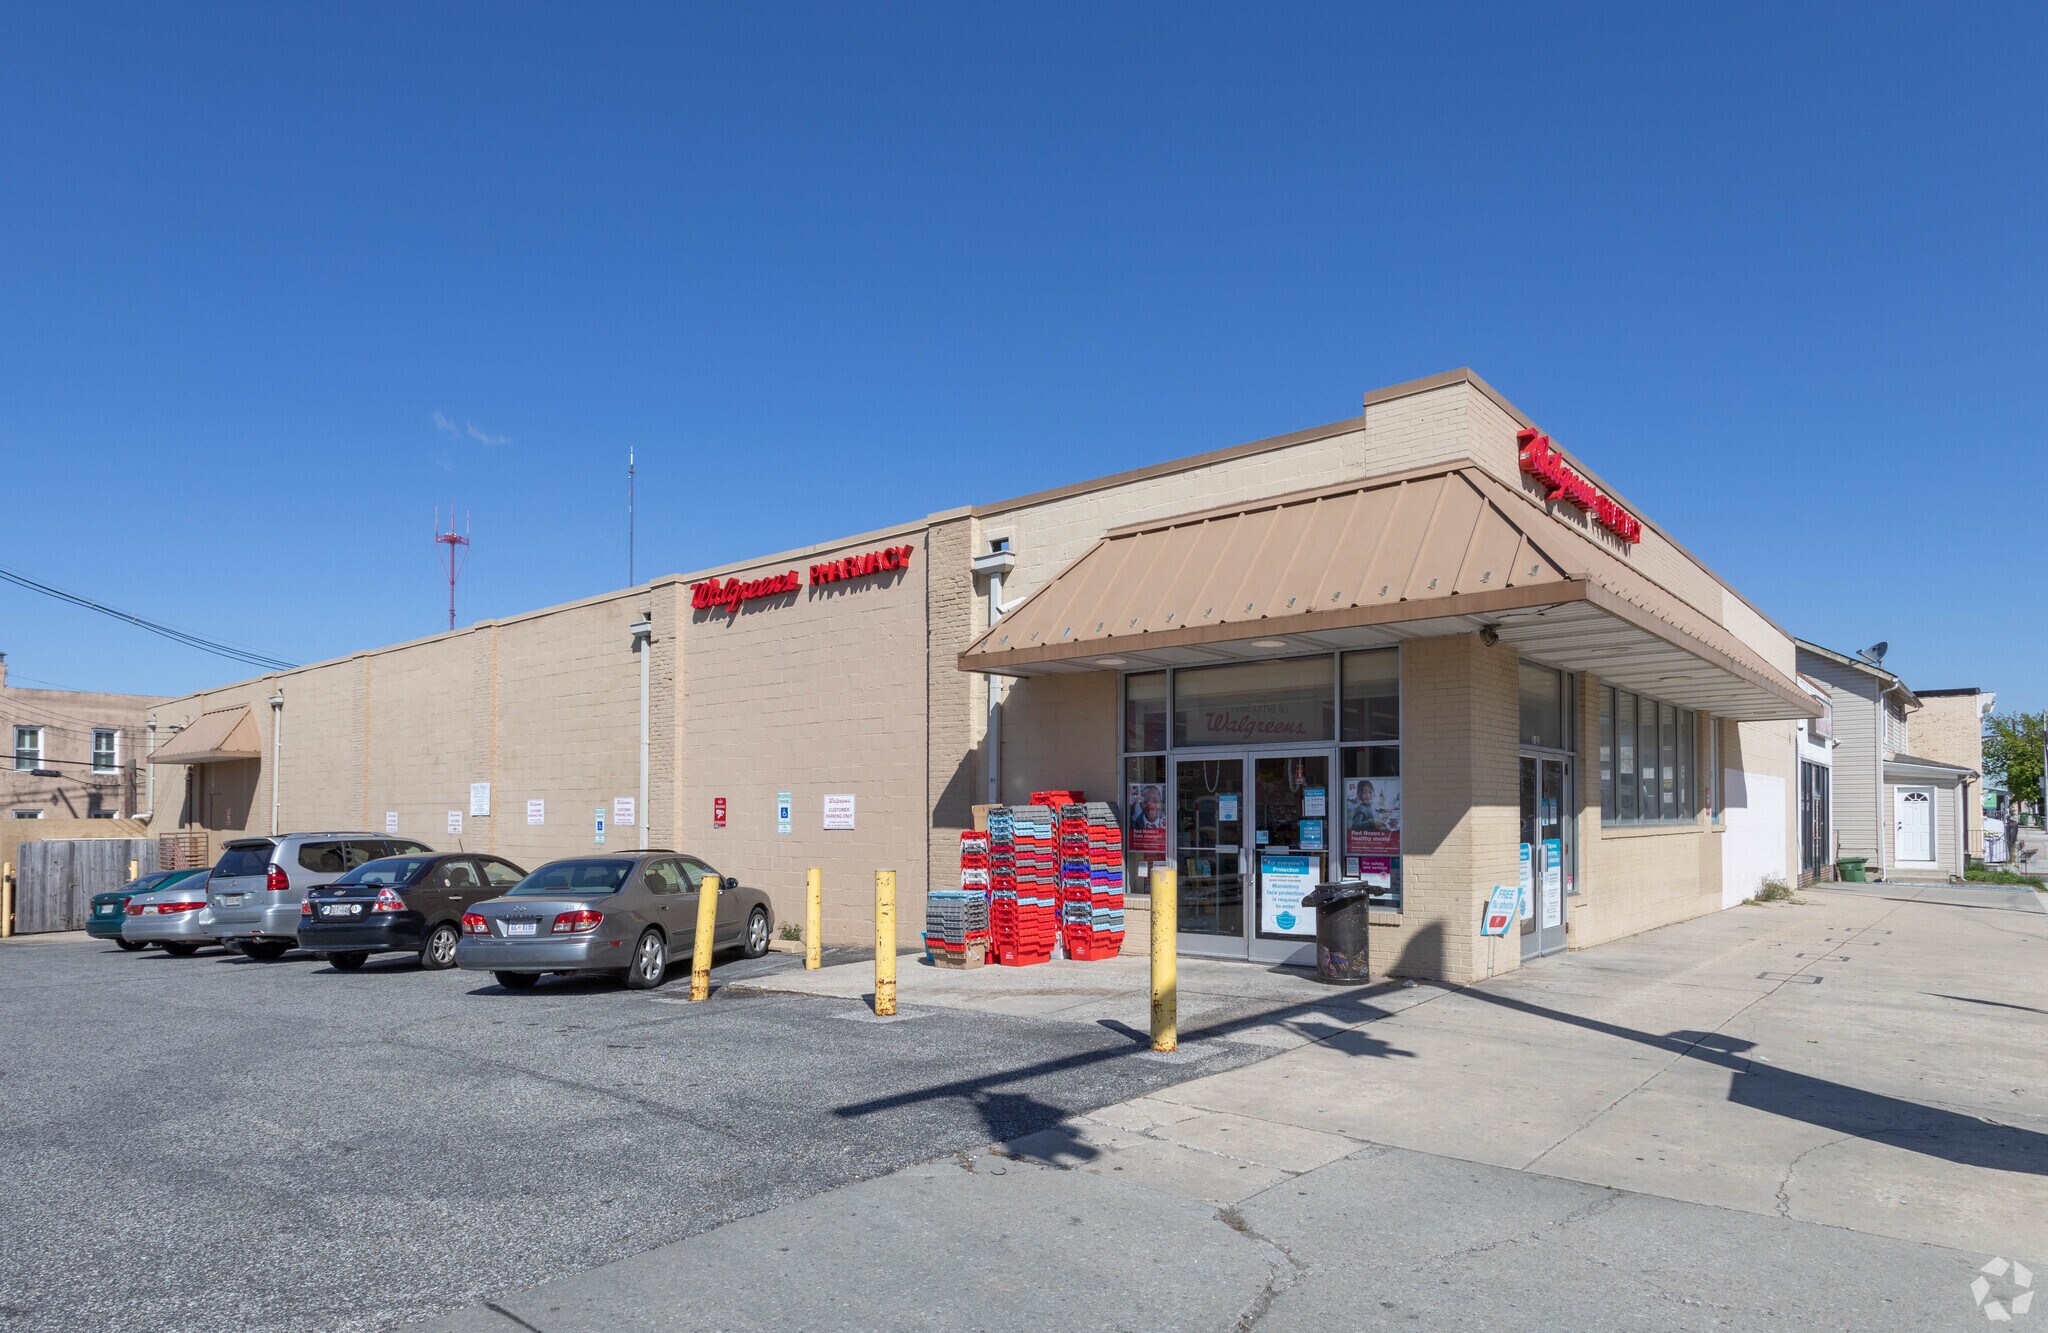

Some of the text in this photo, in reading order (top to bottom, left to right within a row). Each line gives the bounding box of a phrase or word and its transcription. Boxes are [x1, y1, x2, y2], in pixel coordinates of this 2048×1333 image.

[690, 545, 914, 612] Walgreens PHARMACY
[1205, 711, 1306, 739] Walgreens
[1498, 890, 1515, 899] FREE
[1499, 900, 1515, 909] shots
